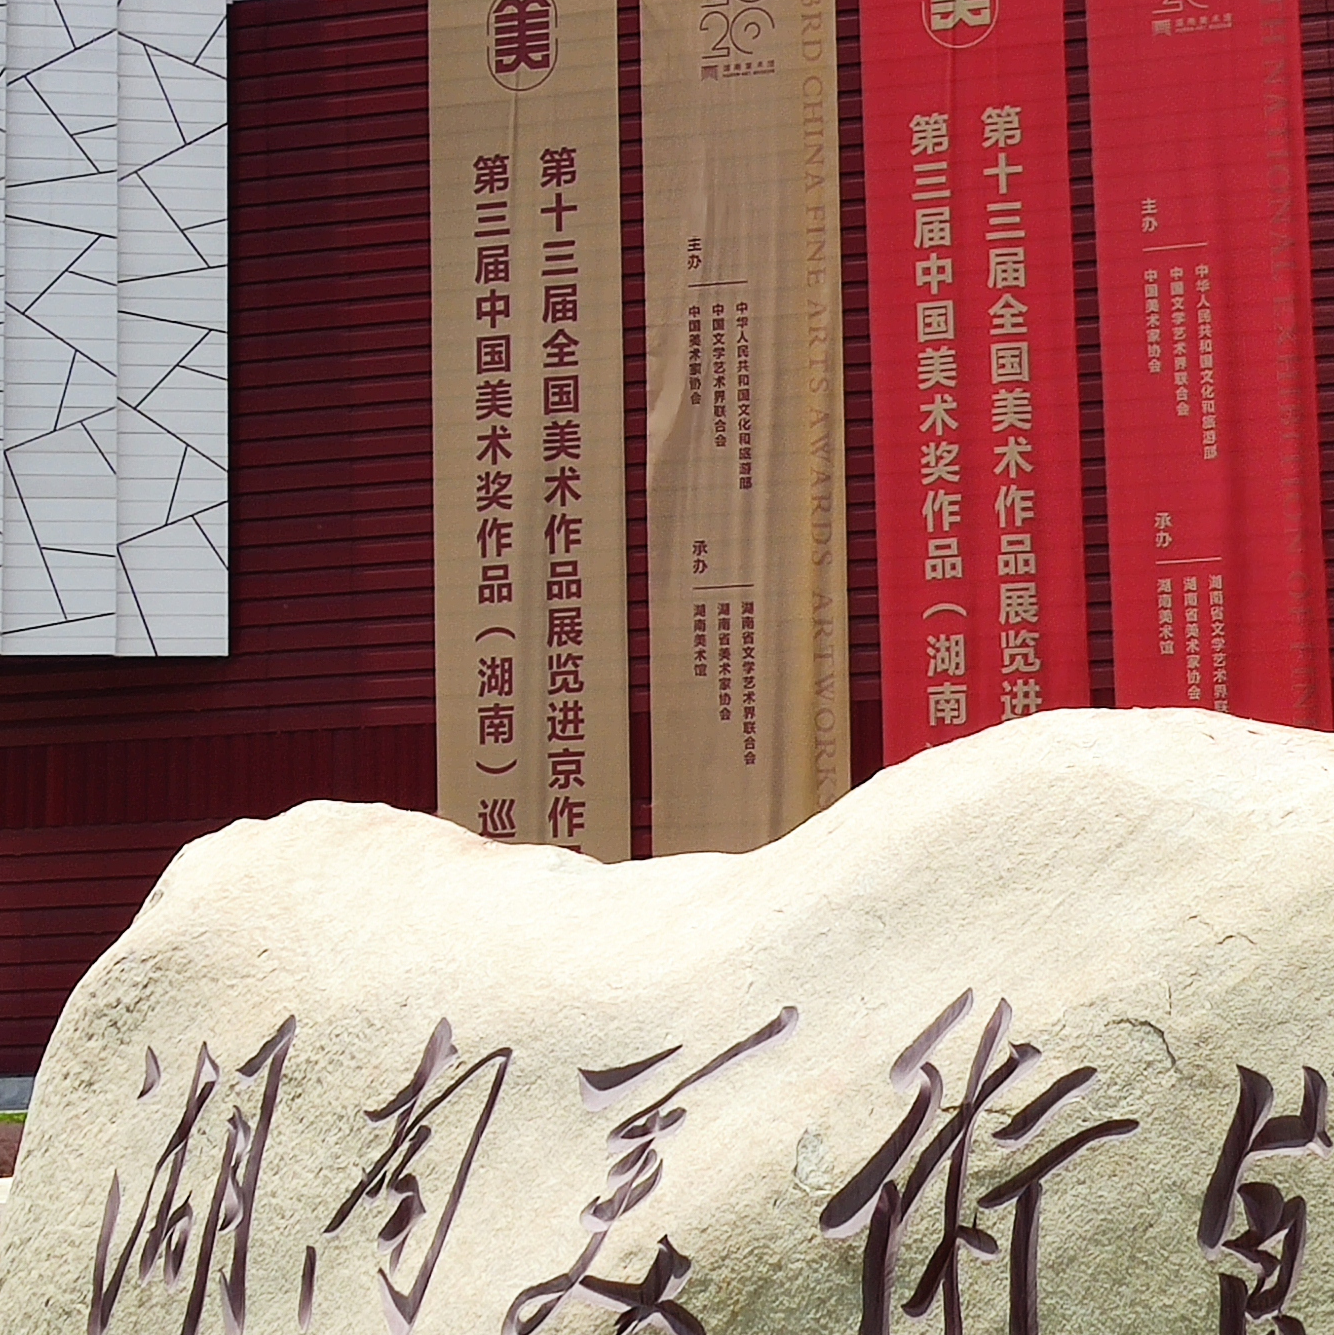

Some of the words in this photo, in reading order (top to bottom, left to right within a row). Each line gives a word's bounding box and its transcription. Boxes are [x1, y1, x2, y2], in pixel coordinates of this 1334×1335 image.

[802, 75, 827, 193] CHINA
[687, 236, 702, 270] 主办
[805, 205, 829, 287] FINE
[1141, 198, 1158, 233] 主办
[688, 305, 702, 405] 中国美术家协会
[712, 303, 727, 447] 中国文学艺术界联合会
[807, 299, 830, 394] ARTS
[909, 112, 967, 748] 第三届中国美术奖作品（湖南
[981, 105, 1044, 721] 第十三届全国美术作品展览进
[539, 146, 586, 854] 第十三届全国美术作品展览进京作
[809, 407, 834, 566] AWARDS
[1154, 512, 1173, 549] 承办
[692, 540, 708, 574] 承办
[741, 601, 756, 765] 湖南省文学艺术界联合会
